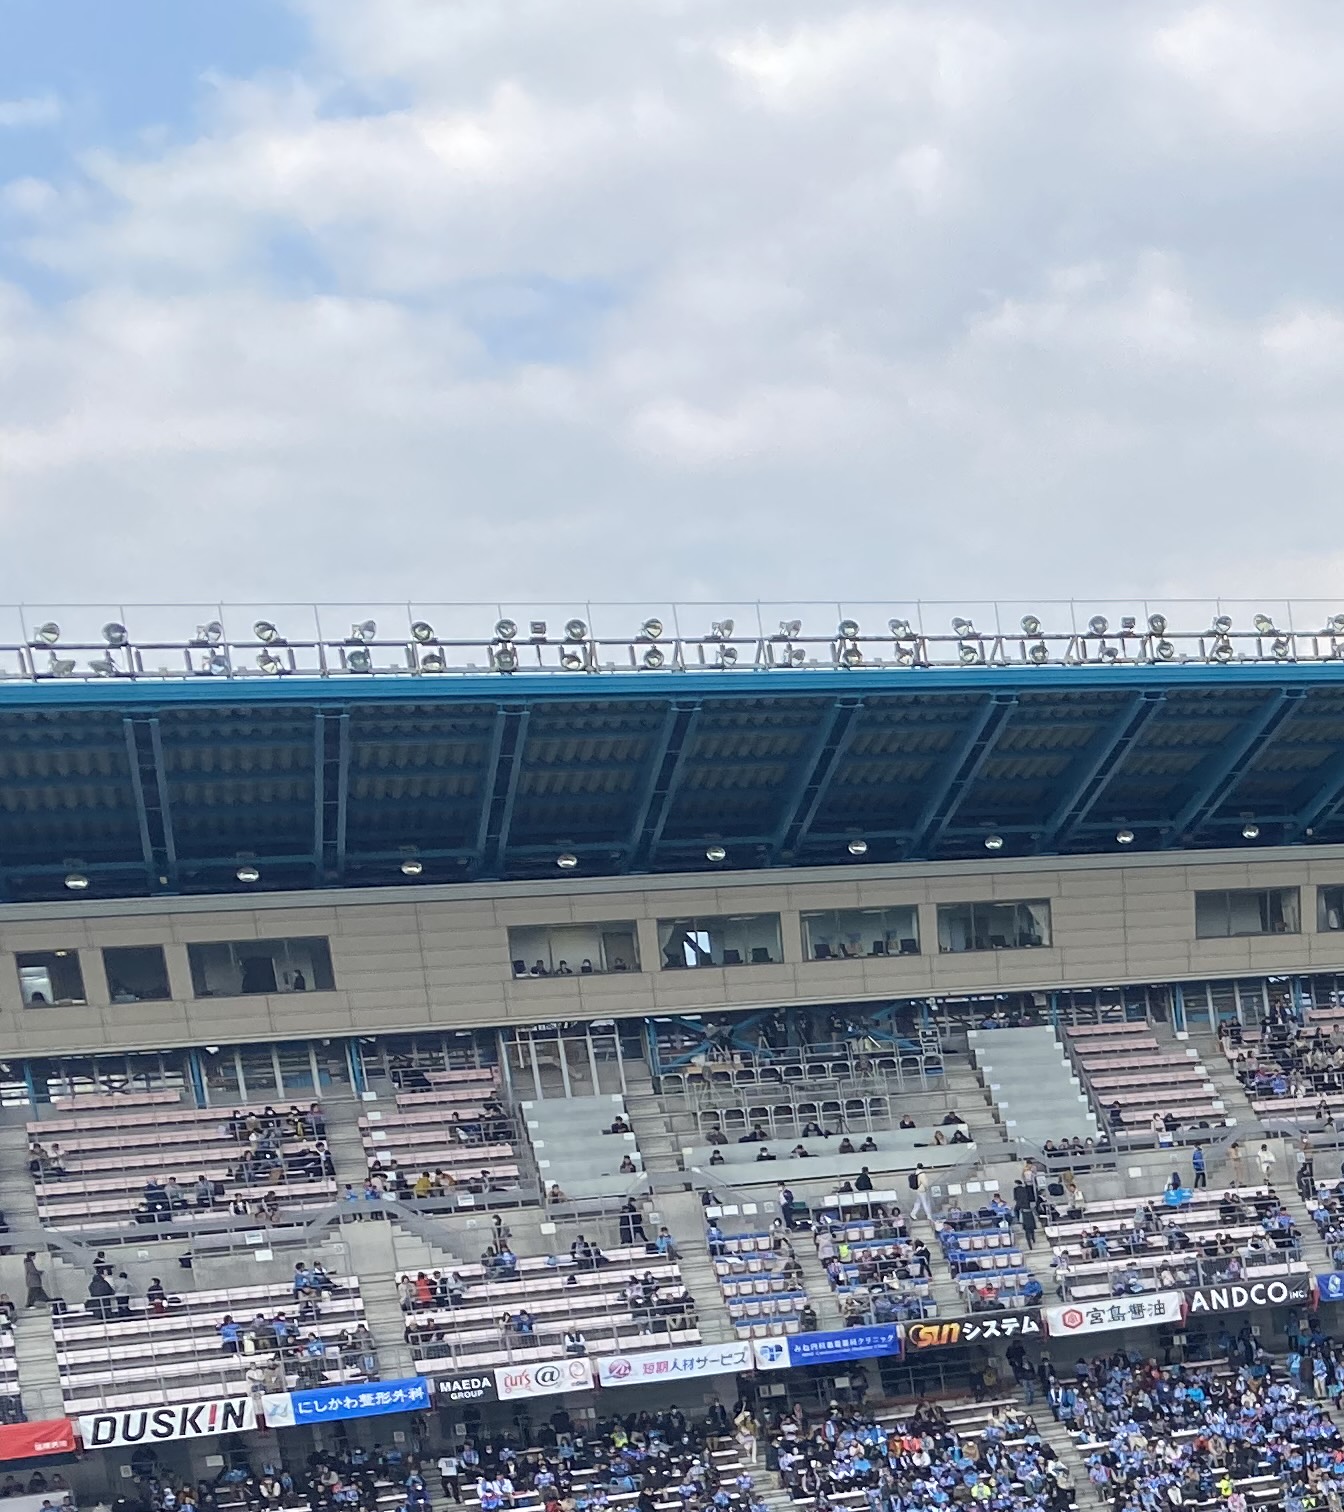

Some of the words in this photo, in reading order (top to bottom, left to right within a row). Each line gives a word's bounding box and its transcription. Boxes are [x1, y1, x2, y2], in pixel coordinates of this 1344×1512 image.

[1191, 1281, 1288, 1313] ANDCO
[642, 1351, 747, 1376] 短期人材サービス
[439, 1377, 492, 1393] MAEDA
[450, 1389, 484, 1400] GROUP
[298, 1386, 425, 1414] にしかわ整形外科
